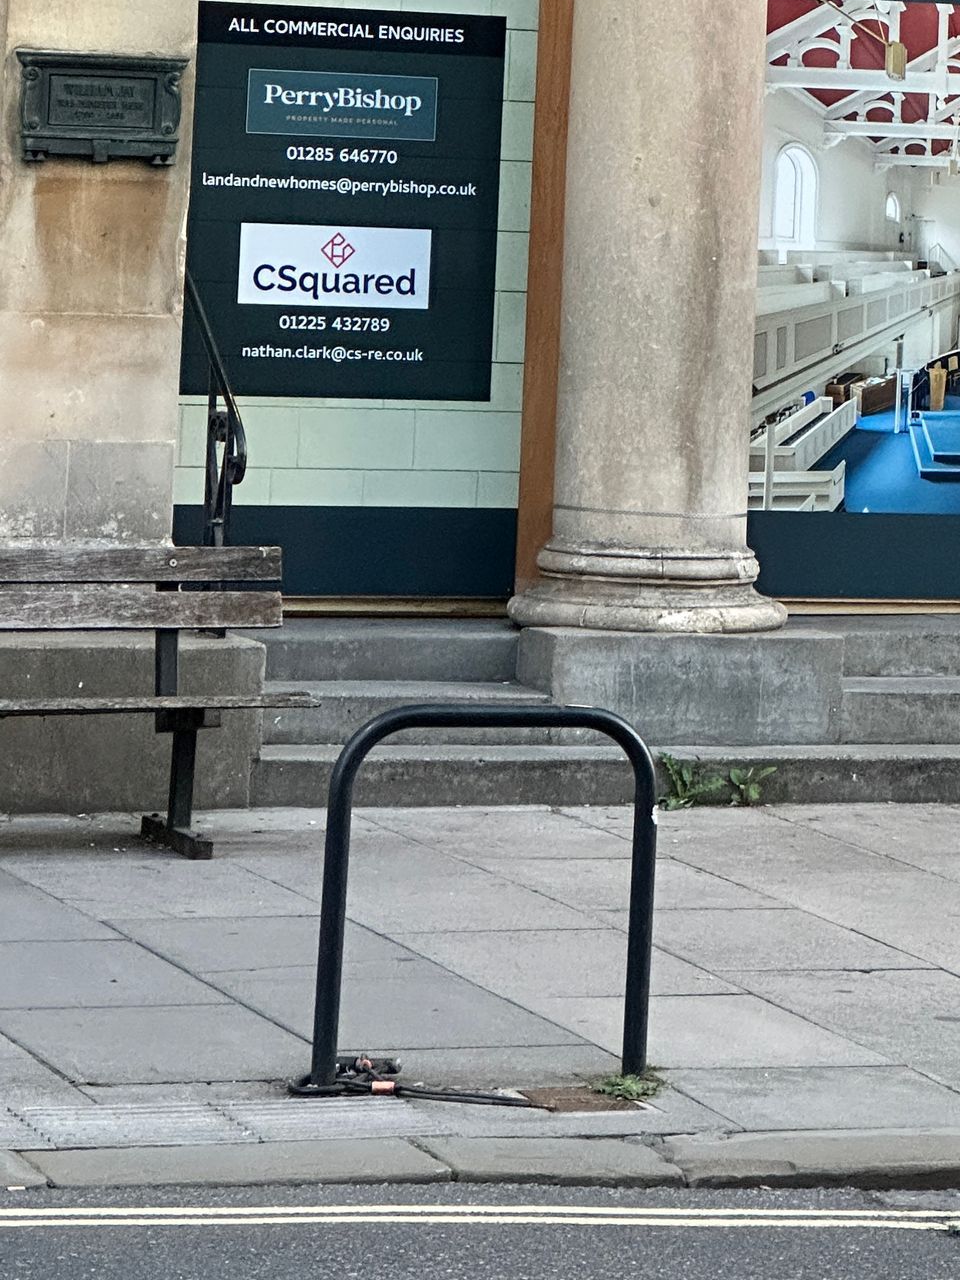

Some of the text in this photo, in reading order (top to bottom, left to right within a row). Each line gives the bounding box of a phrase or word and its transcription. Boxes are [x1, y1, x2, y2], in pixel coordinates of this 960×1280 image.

[228, 17, 465, 43] ALL COMMERCIAL ENQUIRIES
[263, 83, 422, 117] PerryBishop
[286, 146, 398, 165] 01285 646770
[202, 171, 477, 199] landandnewhomes@perrybishop.co.uk
[252, 264, 416, 300] CSquared
[278, 314, 390, 332] 01225 432789
[241, 344, 423, 363] nathan.clark@cs-re.co.uk
